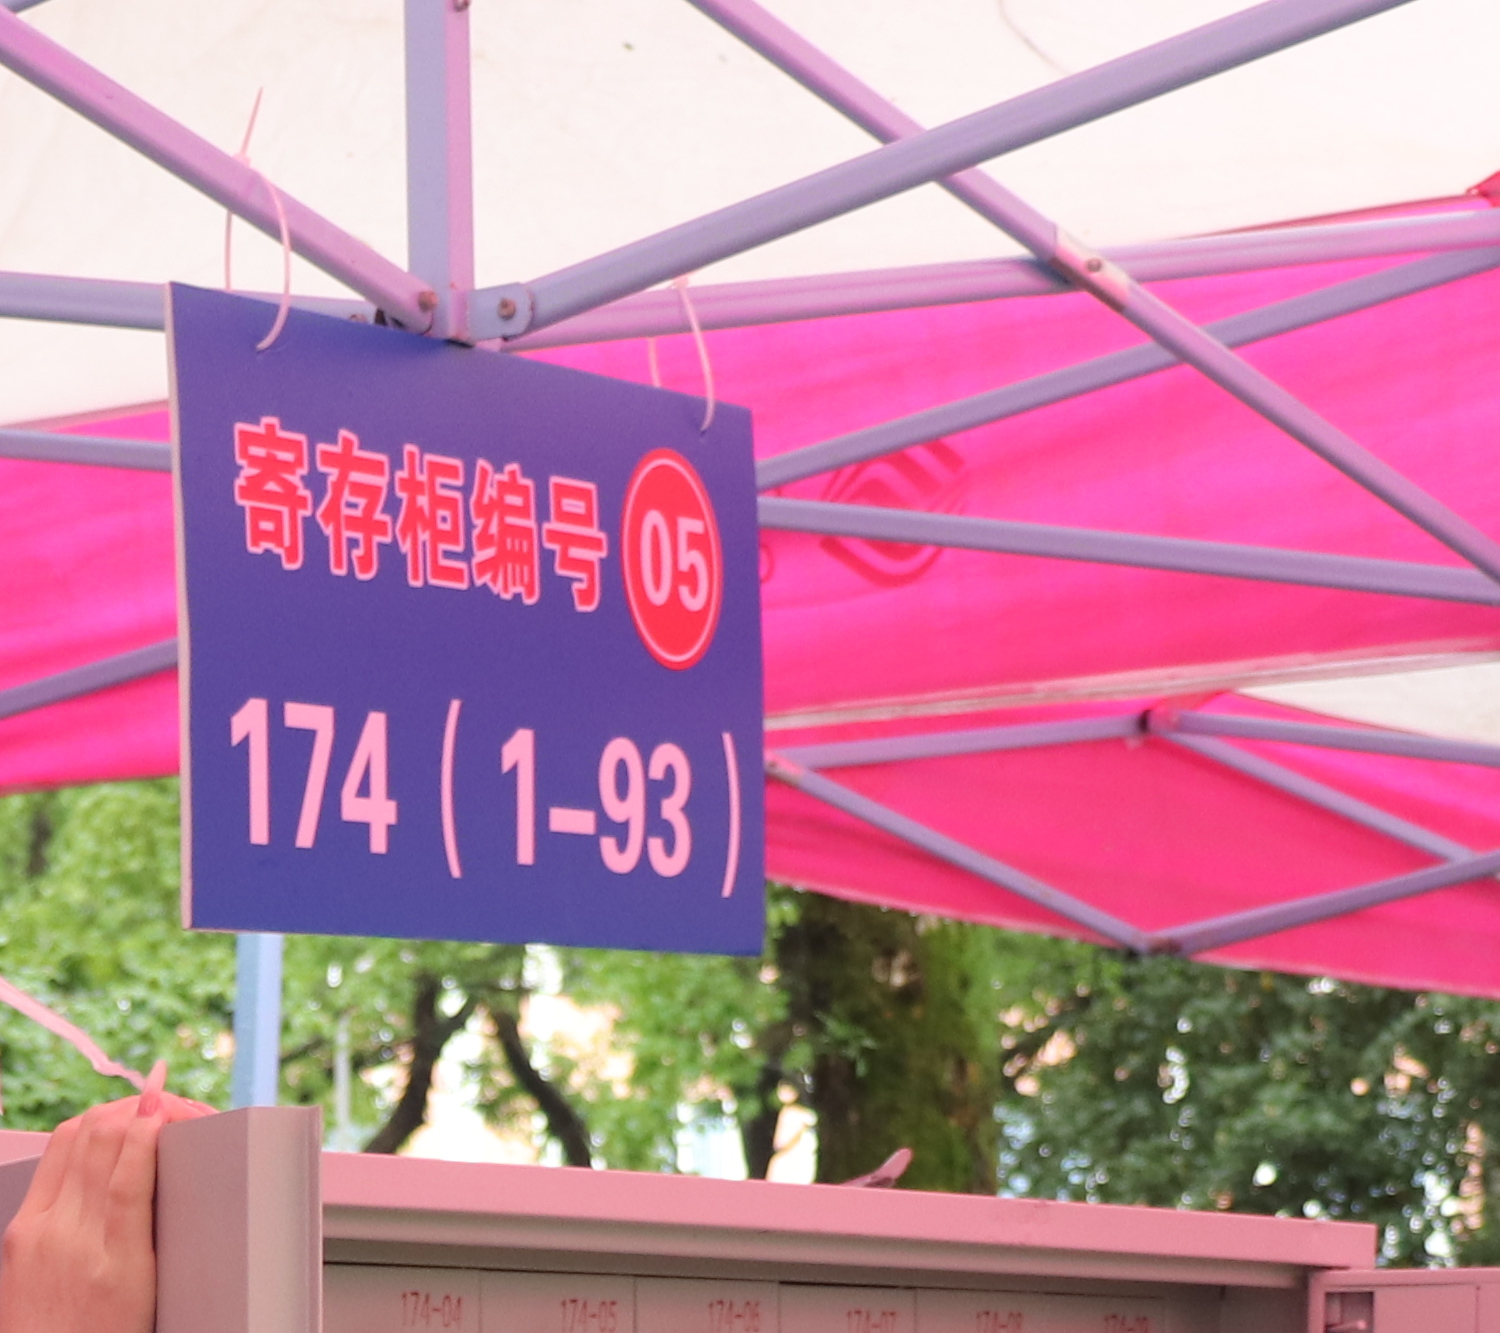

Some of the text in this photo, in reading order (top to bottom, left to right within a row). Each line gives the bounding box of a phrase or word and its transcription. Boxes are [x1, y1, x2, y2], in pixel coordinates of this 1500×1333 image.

[234, 417, 709, 612] 寄存柜编号 05
[230, 698, 397, 855] 174
[402, 1292, 463, 1328] 174-04
